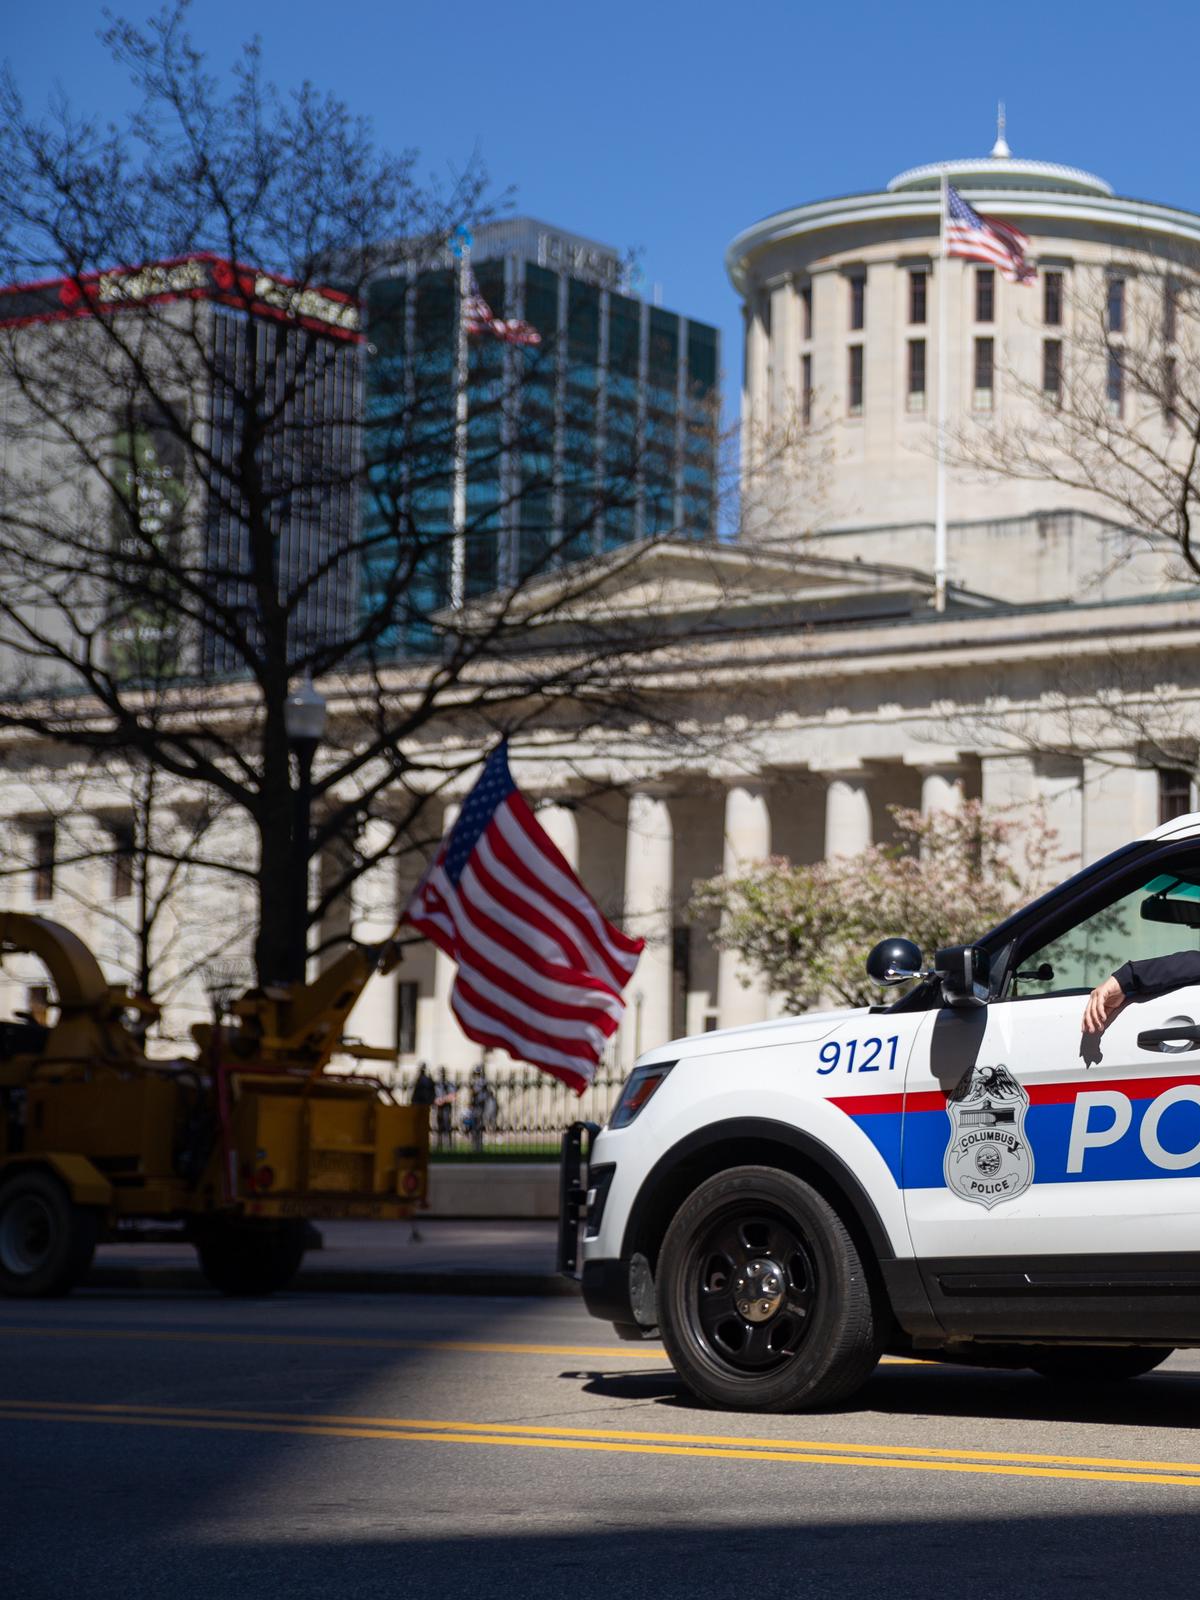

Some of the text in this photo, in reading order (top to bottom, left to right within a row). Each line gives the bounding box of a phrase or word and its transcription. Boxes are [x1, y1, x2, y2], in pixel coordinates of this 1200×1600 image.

[816, 1035, 899, 1076] 9121
[960, 1131, 1014, 1148] COLUMBUS
[970, 1180, 1009, 1194] POLICE
